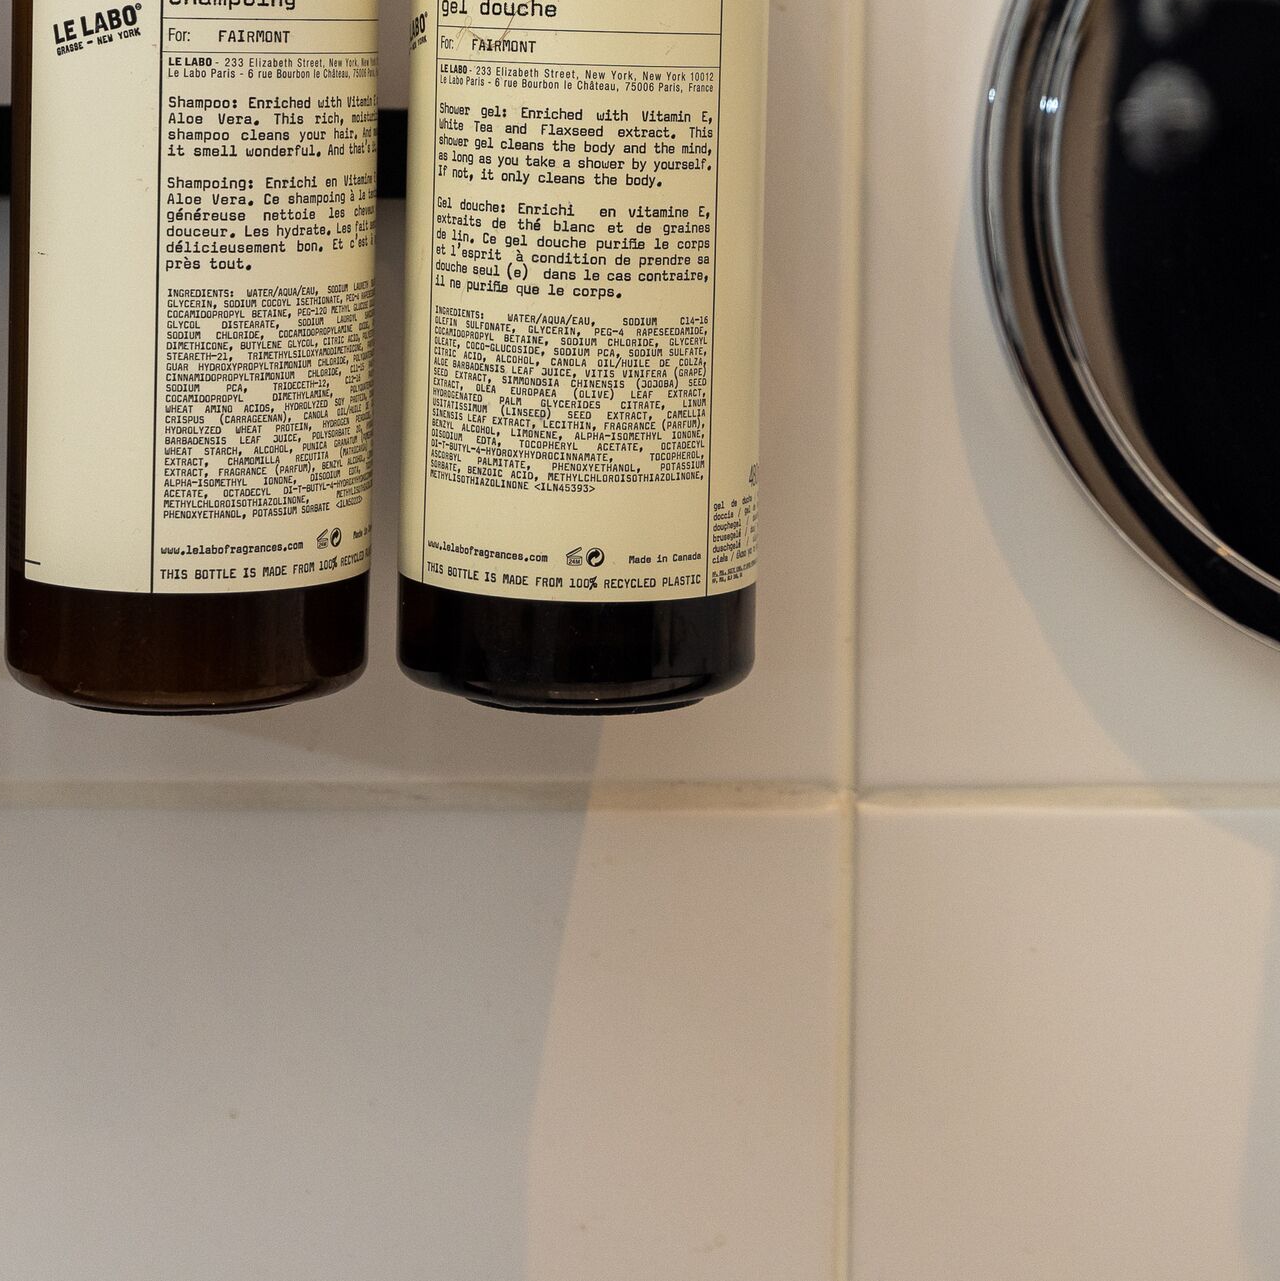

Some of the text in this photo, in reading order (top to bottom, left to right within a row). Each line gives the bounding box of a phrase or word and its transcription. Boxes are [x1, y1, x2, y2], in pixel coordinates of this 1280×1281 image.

[53, 19, 77, 45] LE
[57, 41, 84, 56] GRASSE
[97, 34, 113, 45] NEW
[117, 27, 141, 39] YORK
[168, 28, 290, 43] For: FAIRMONT
[441, 35, 454, 49] For:
[471, 39, 536, 54] FAIRMONT
[440, 64, 448, 73] LE
[450, 64, 468, 74] LABO
[474, 66, 491, 76] 233
[496, 67, 539, 80] Elizabeth
[544, 68, 579, 80] Street,
[585, 69, 605, 80] New
[611, 70, 637, 81] York,
[642, 71, 661, 83] New
[666, 72, 686, 82] York
[690, 72, 713, 82] 10012
[440, 75, 447, 84] Le
[449, 75, 463, 85] Labo
[466, 76, 485, 86] Paris
[495, 77, 500, 87] 6
[504, 80, 520, 88] rue
[522, 80, 559, 89] Bourbon
[564, 80, 572, 90] le
[576, 80, 619, 92] Château,
[625, 82, 654, 92] 75006
[658, 82, 683, 93] Paris,
[689, 83, 713, 92] France
[168, 96, 342, 111] Shampoo: Enriched with
[168, 112, 344, 126] Aloe Vera. This rich,
[440, 102, 712, 125] Shower gel: Enriched with Vitamin E,
[474, 120, 493, 133] Tea
[505, 122, 527, 134] and
[541, 120, 603, 137] Flaxseed
[618, 126, 676, 139] extract.
[689, 126, 713, 138] This
[435, 305, 657, 326] INGREDIENTS: WATER/AQUA/EAU, SODIUM
[161, 542, 303, 556] www.lelabofragrances.com
[428, 540, 548, 562] www.lelabofragrances.com
[629, 552, 701, 564] Made in Canada
[160, 551, 364, 580] THIS BOTTLE IS MADE FROM 100% RECYCLED
[427, 561, 701, 590] THIS BOTTLE IS MADE FROM 100% RECYCLED PLASTIC
